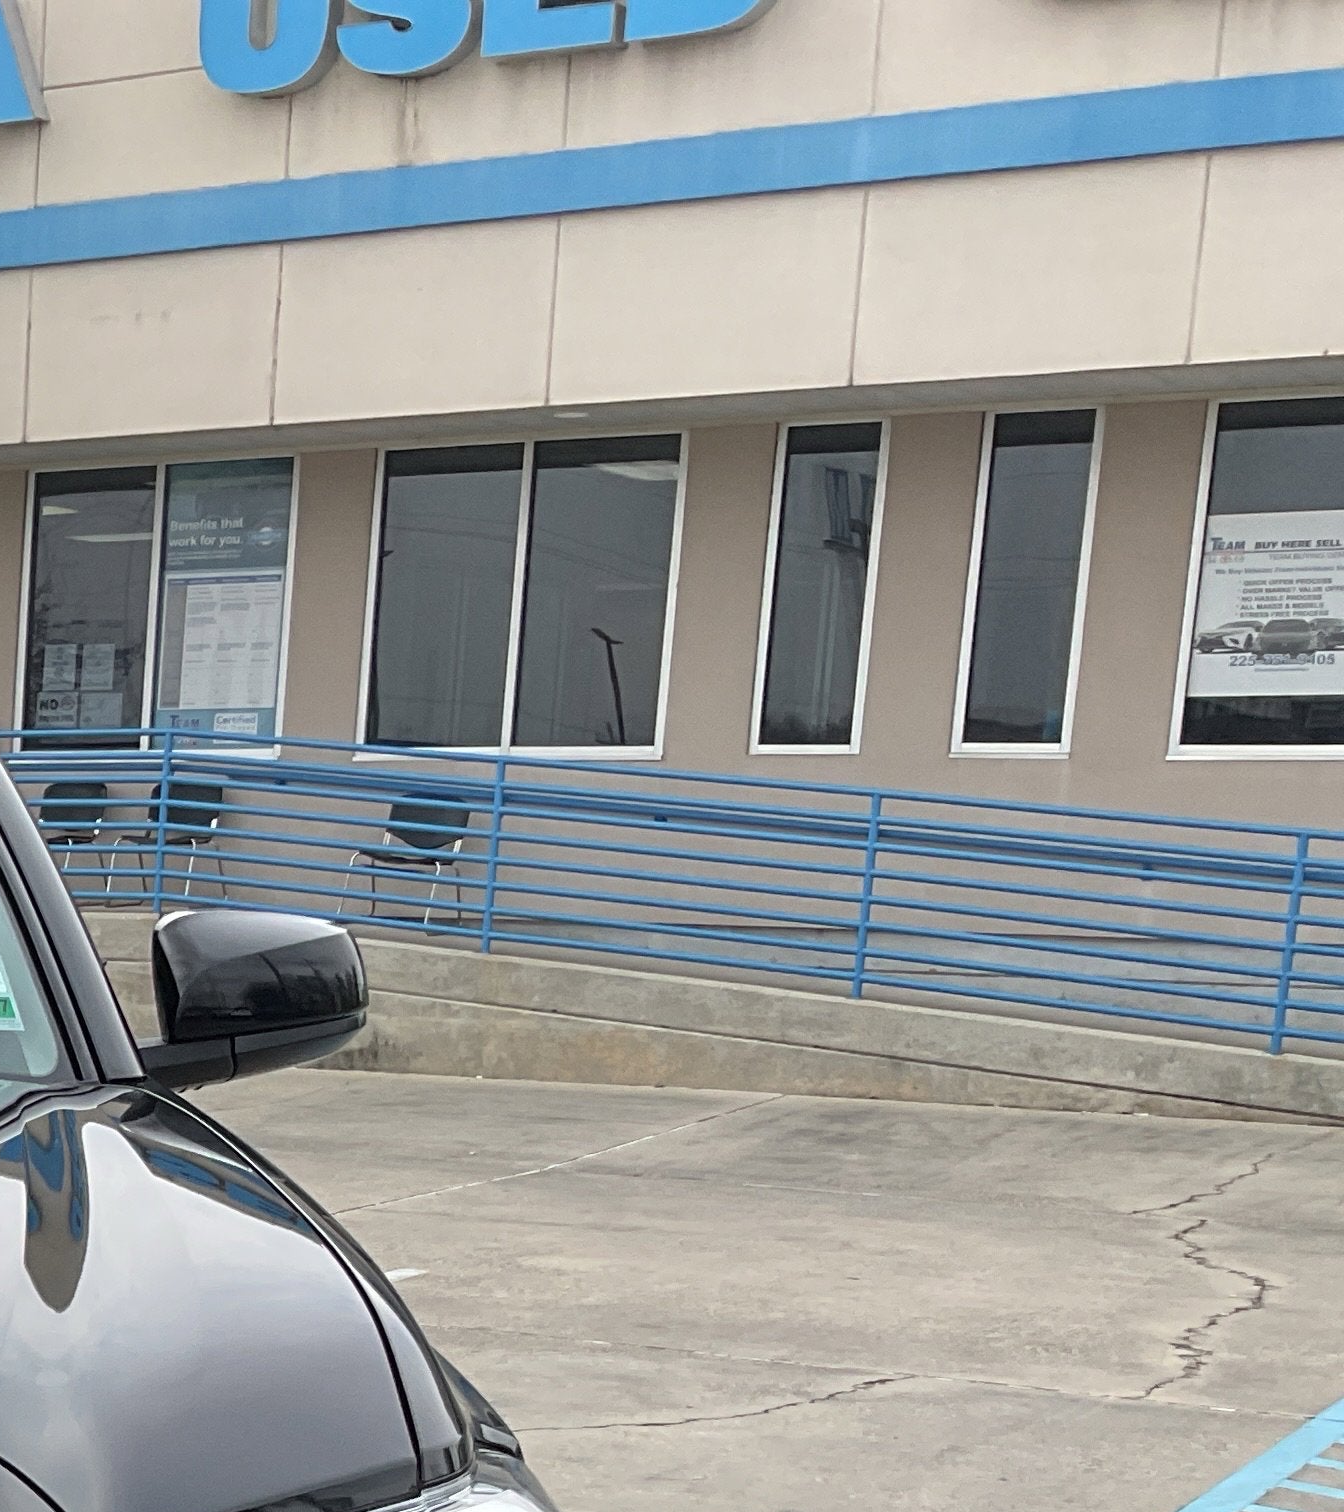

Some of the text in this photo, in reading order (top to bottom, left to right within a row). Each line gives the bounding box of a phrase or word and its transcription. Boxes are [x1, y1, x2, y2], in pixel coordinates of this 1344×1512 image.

[199, 0, 768, 95] US
[170, 516, 244, 531] Benefits that
[169, 536, 197, 547] work
[200, 535, 217, 546] for
[1210, 537, 1246, 551] TEAM
[1254, 539, 1343, 550] BUY HERE SELL
[39, 699, 59, 711] NO
